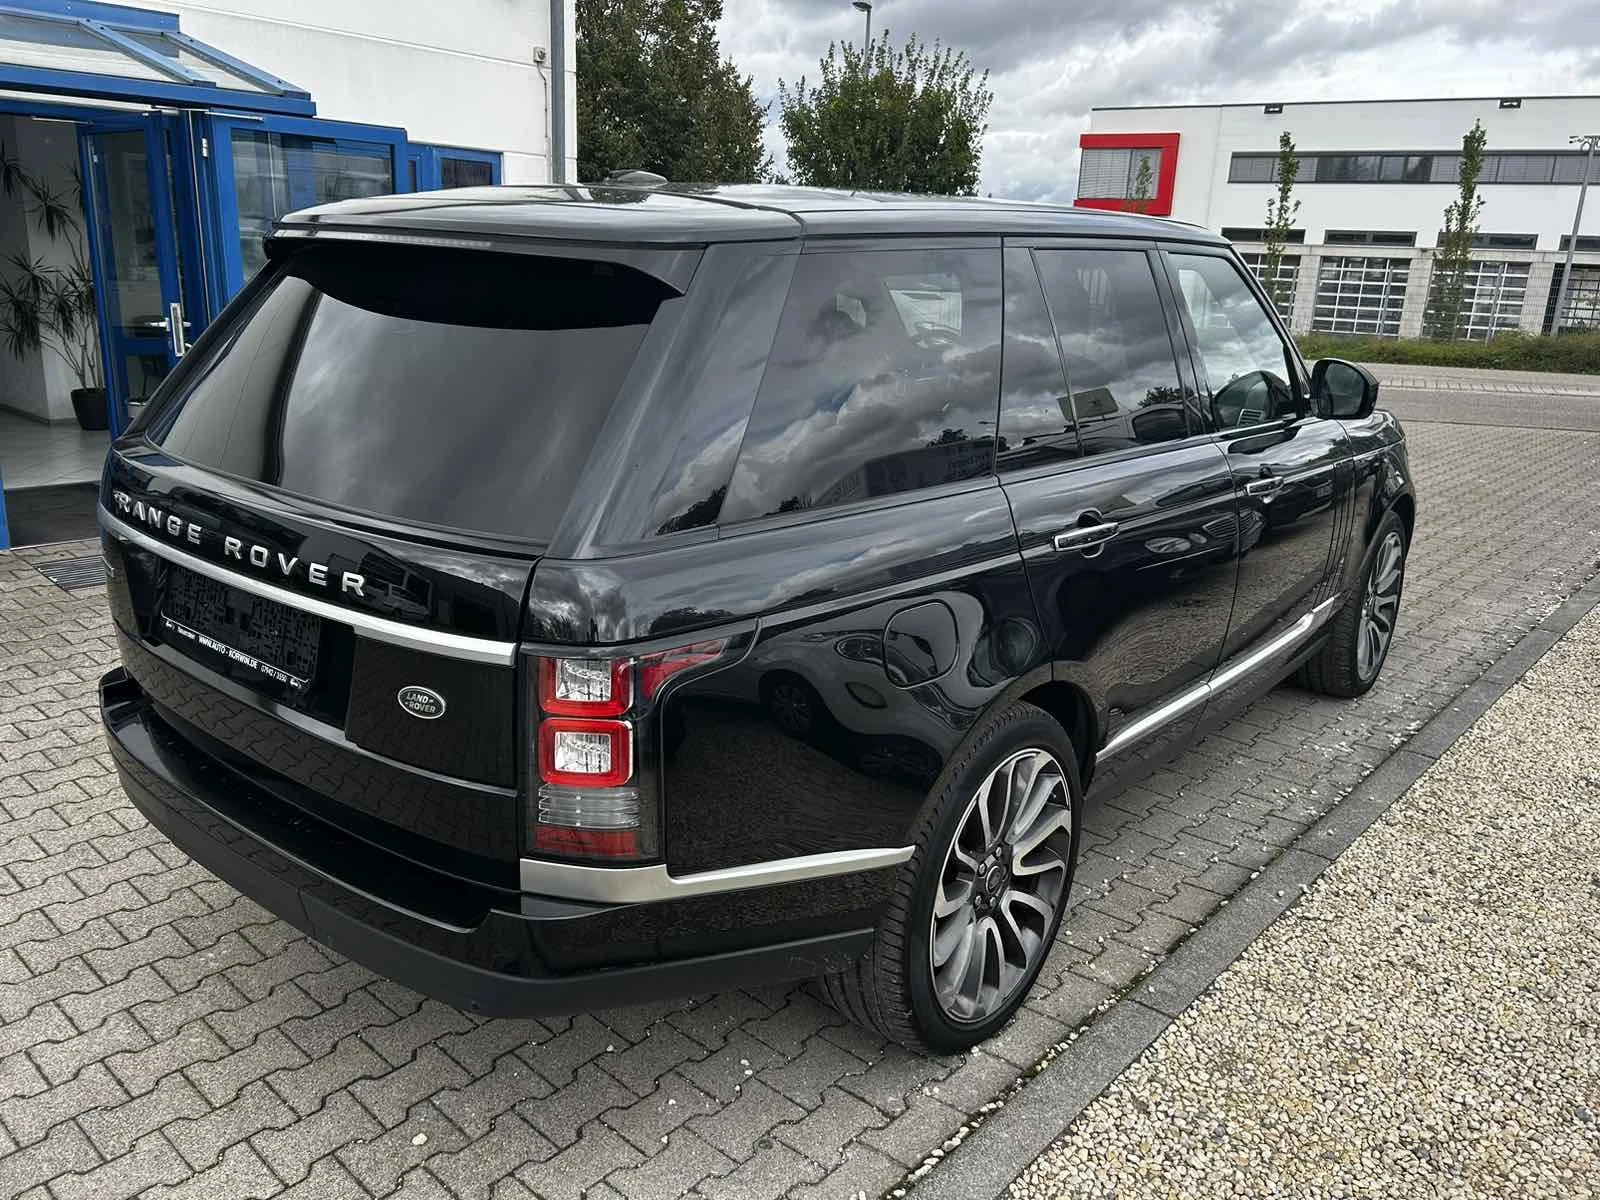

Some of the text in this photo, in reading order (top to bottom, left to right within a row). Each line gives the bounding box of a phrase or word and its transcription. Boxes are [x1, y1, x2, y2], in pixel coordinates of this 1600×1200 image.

[115, 491, 365, 597] RANGE ROVER
[406, 691, 429, 704] LAND
[408, 701, 436, 713] ROVER
